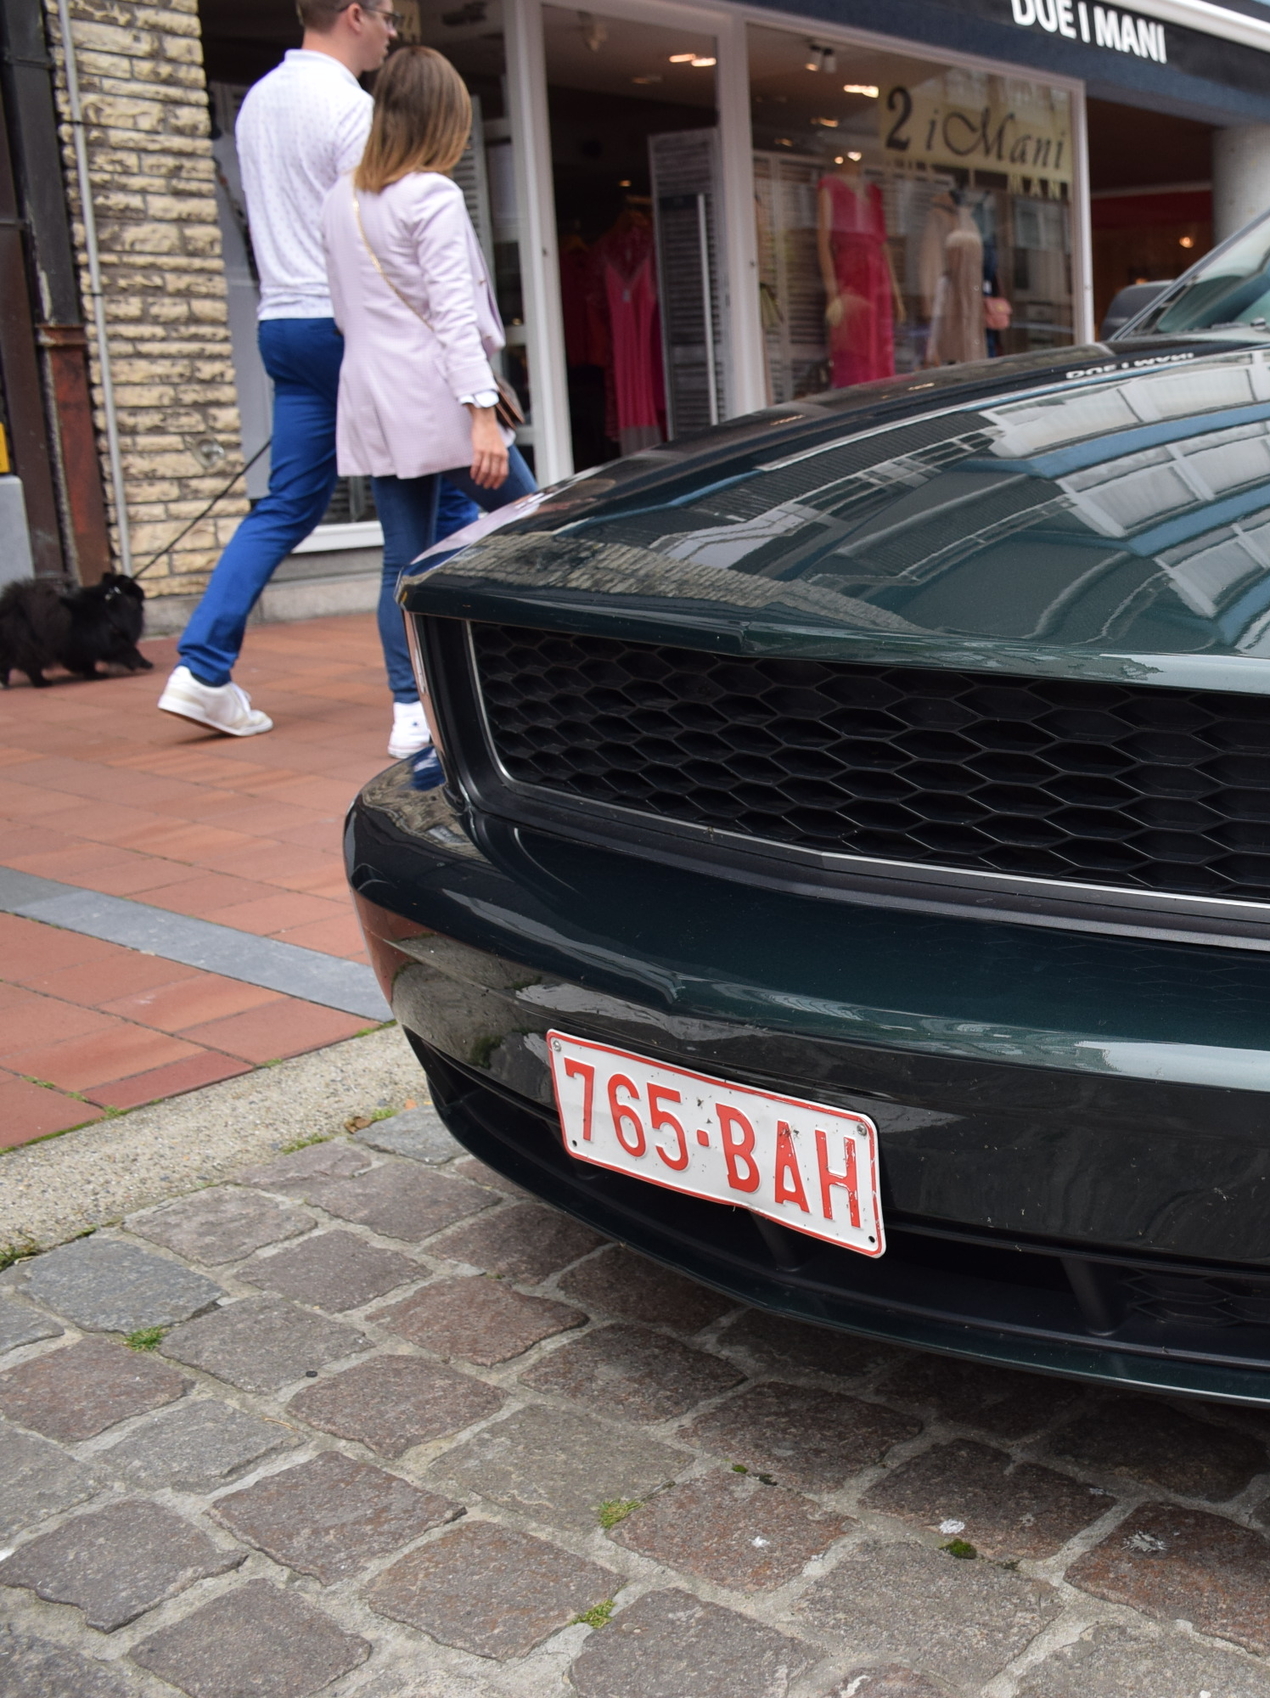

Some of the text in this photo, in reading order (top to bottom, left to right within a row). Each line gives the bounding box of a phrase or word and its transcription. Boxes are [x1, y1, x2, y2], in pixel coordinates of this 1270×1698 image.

[1078, 1, 1091, 43] I
[1093, 5, 1168, 64] MANI
[885, 86, 912, 151] 2
